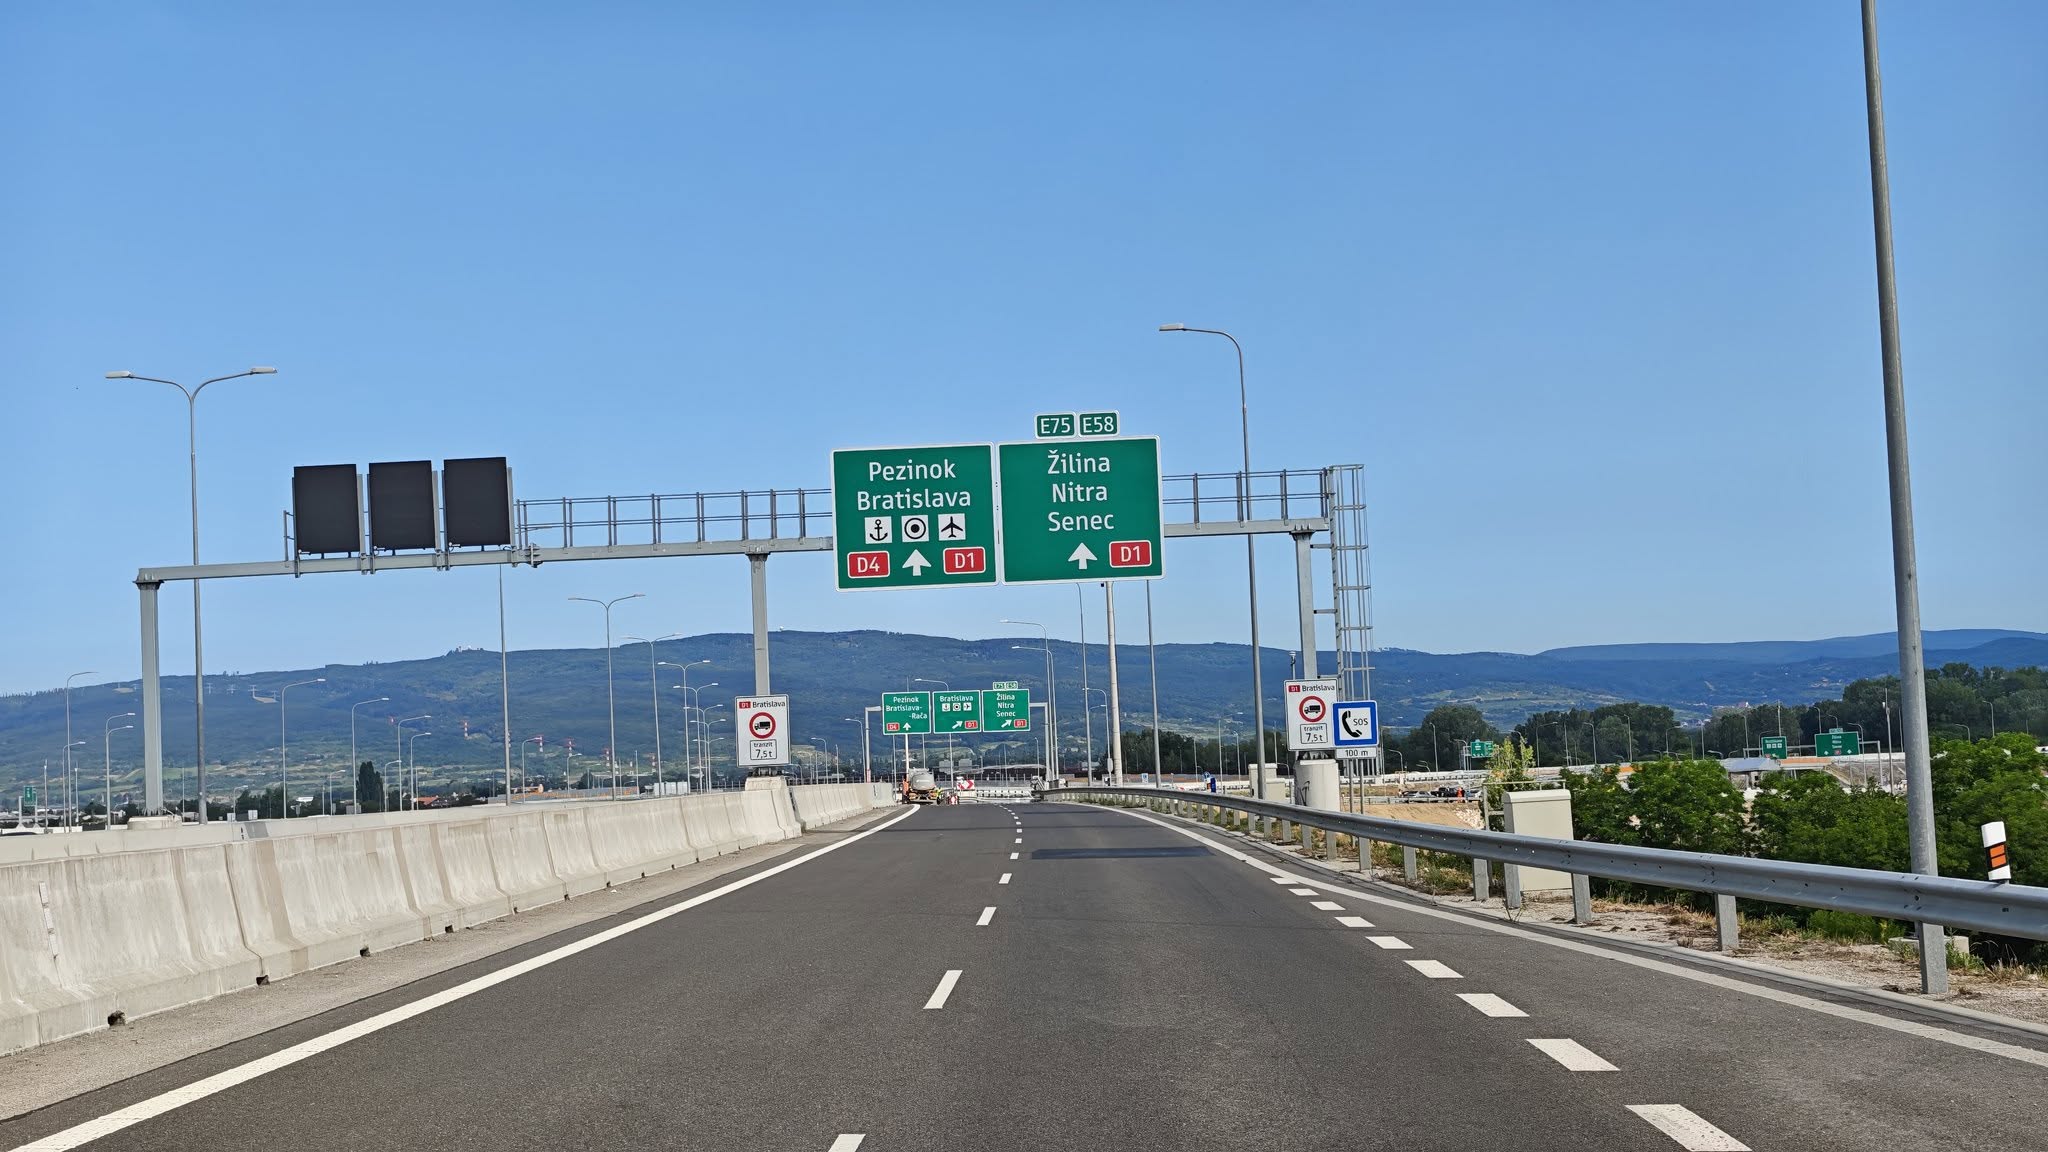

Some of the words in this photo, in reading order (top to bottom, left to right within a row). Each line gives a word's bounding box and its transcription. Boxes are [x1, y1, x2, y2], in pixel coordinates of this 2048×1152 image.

[1040, 418, 1071, 434] E75
[1082, 416, 1114, 432] E58
[868, 459, 956, 482] Pezinok
[1047, 450, 1110, 474] Žilina
[857, 488, 971, 511] Bratislava
[1051, 482, 1108, 503] Nitra
[1048, 512, 1114, 532] Senec
[954, 552, 976, 569] D1
[1120, 546, 1142, 563] D1
[857, 557, 880, 574] D4
[1353, 718, 1368, 726] SOS
[1306, 733, 1318, 742] 7,5
[756, 750, 767, 758] 7,5
